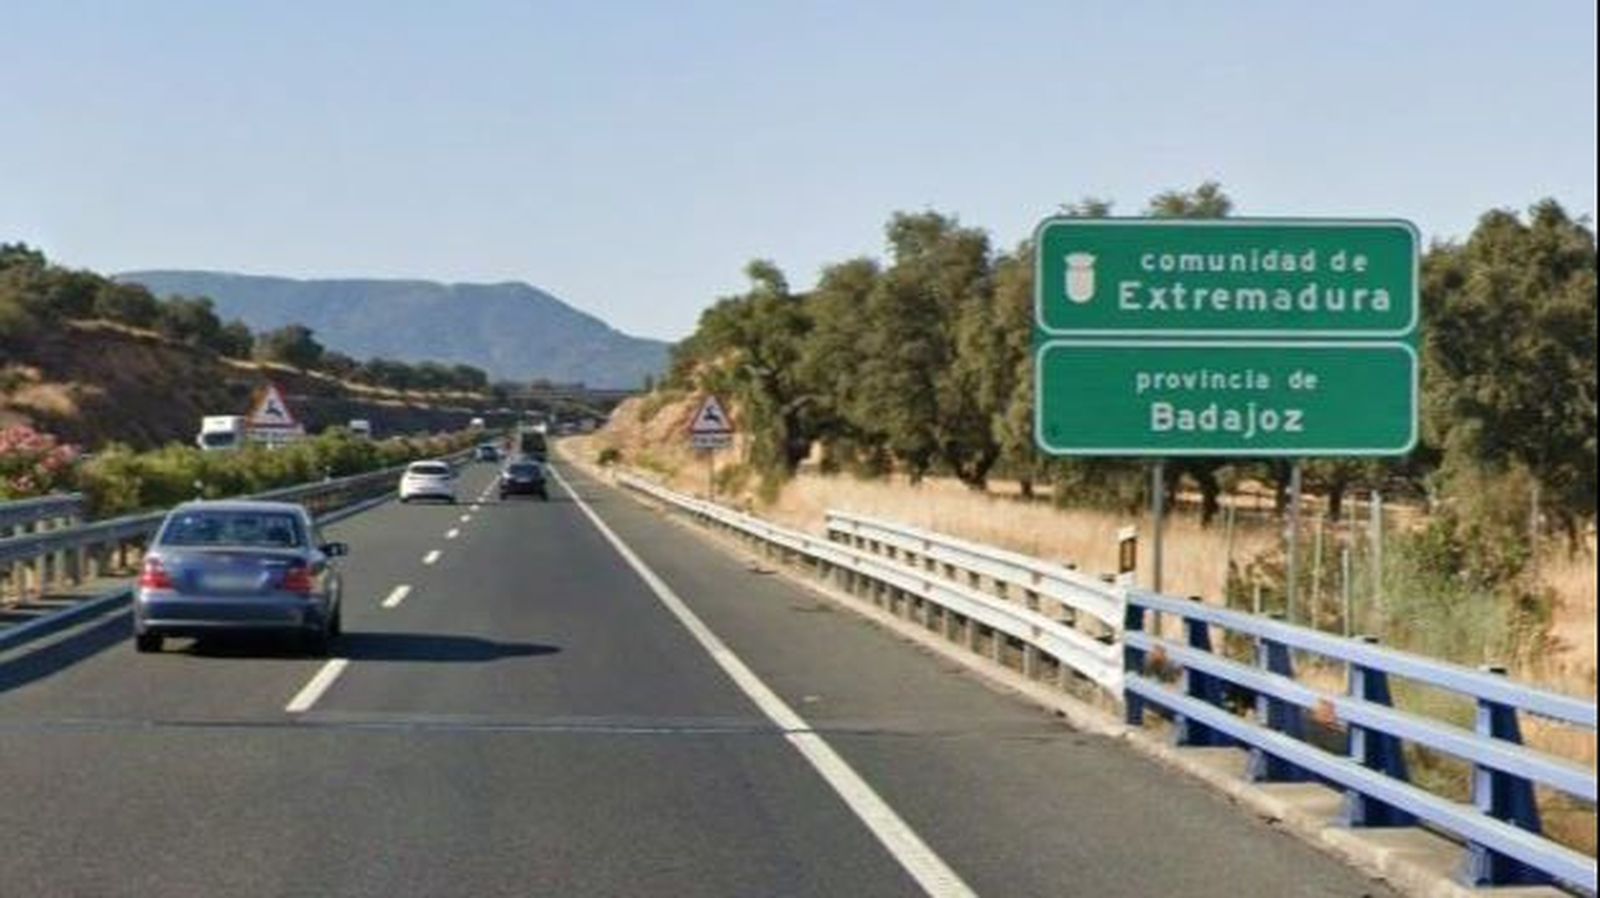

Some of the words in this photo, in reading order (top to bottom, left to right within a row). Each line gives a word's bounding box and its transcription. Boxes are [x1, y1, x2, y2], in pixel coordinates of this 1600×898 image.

[1140, 249, 1315, 272] comunidad
[1330, 250, 1368, 272] de
[1118, 281, 1391, 311] Extremadura
[1136, 369, 1271, 393] provincia
[1288, 369, 1319, 390] de
[1150, 402, 1304, 438] Badajoz
